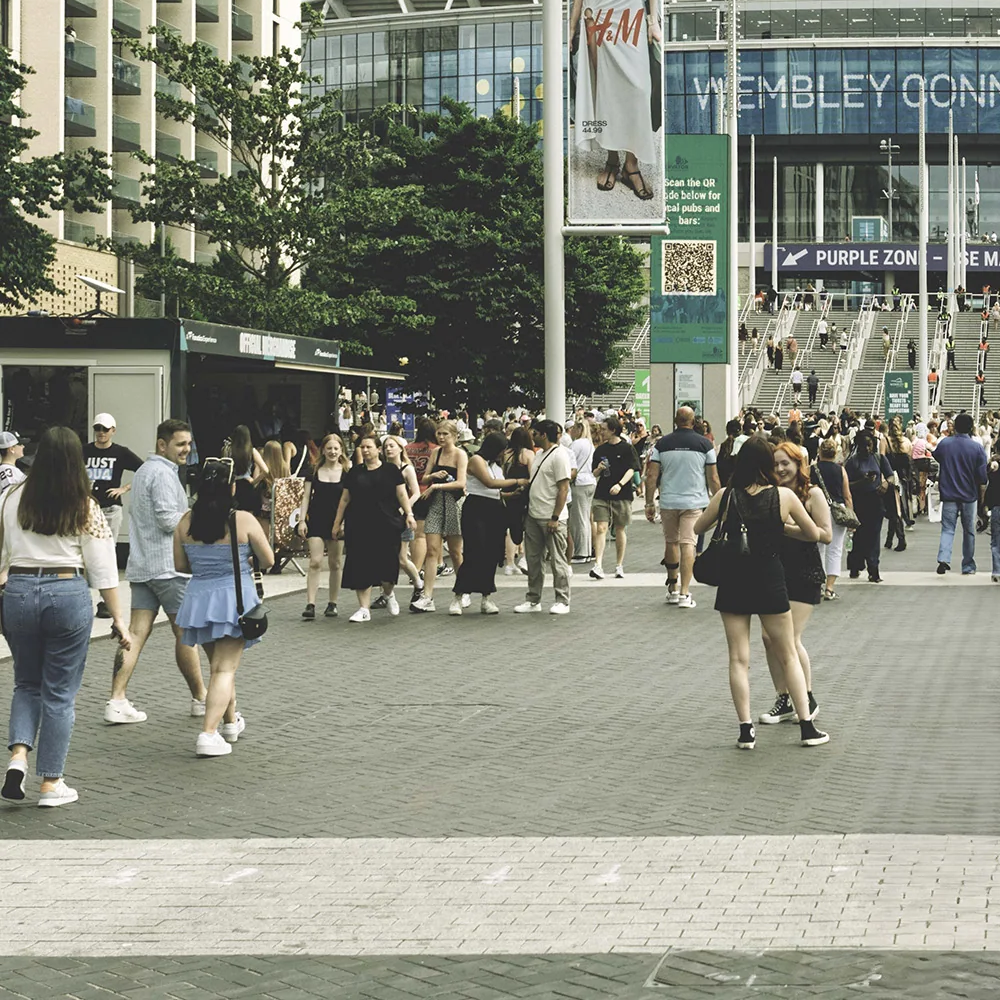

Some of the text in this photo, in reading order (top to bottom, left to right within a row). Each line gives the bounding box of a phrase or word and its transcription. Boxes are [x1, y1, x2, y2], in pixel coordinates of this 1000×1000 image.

[586, 7, 645, 48] H&M
[664, 178, 716, 188] Scan the QR
[681, 190, 706, 200] below
[708, 190, 721, 200] for
[682, 203, 703, 214] pubs
[705, 203, 721, 213] and
[678, 215, 701, 225] bars:
[816, 249, 879, 266] PURPLE
[883, 249, 928, 266] ZON
[84, 457, 117, 469] JUST
